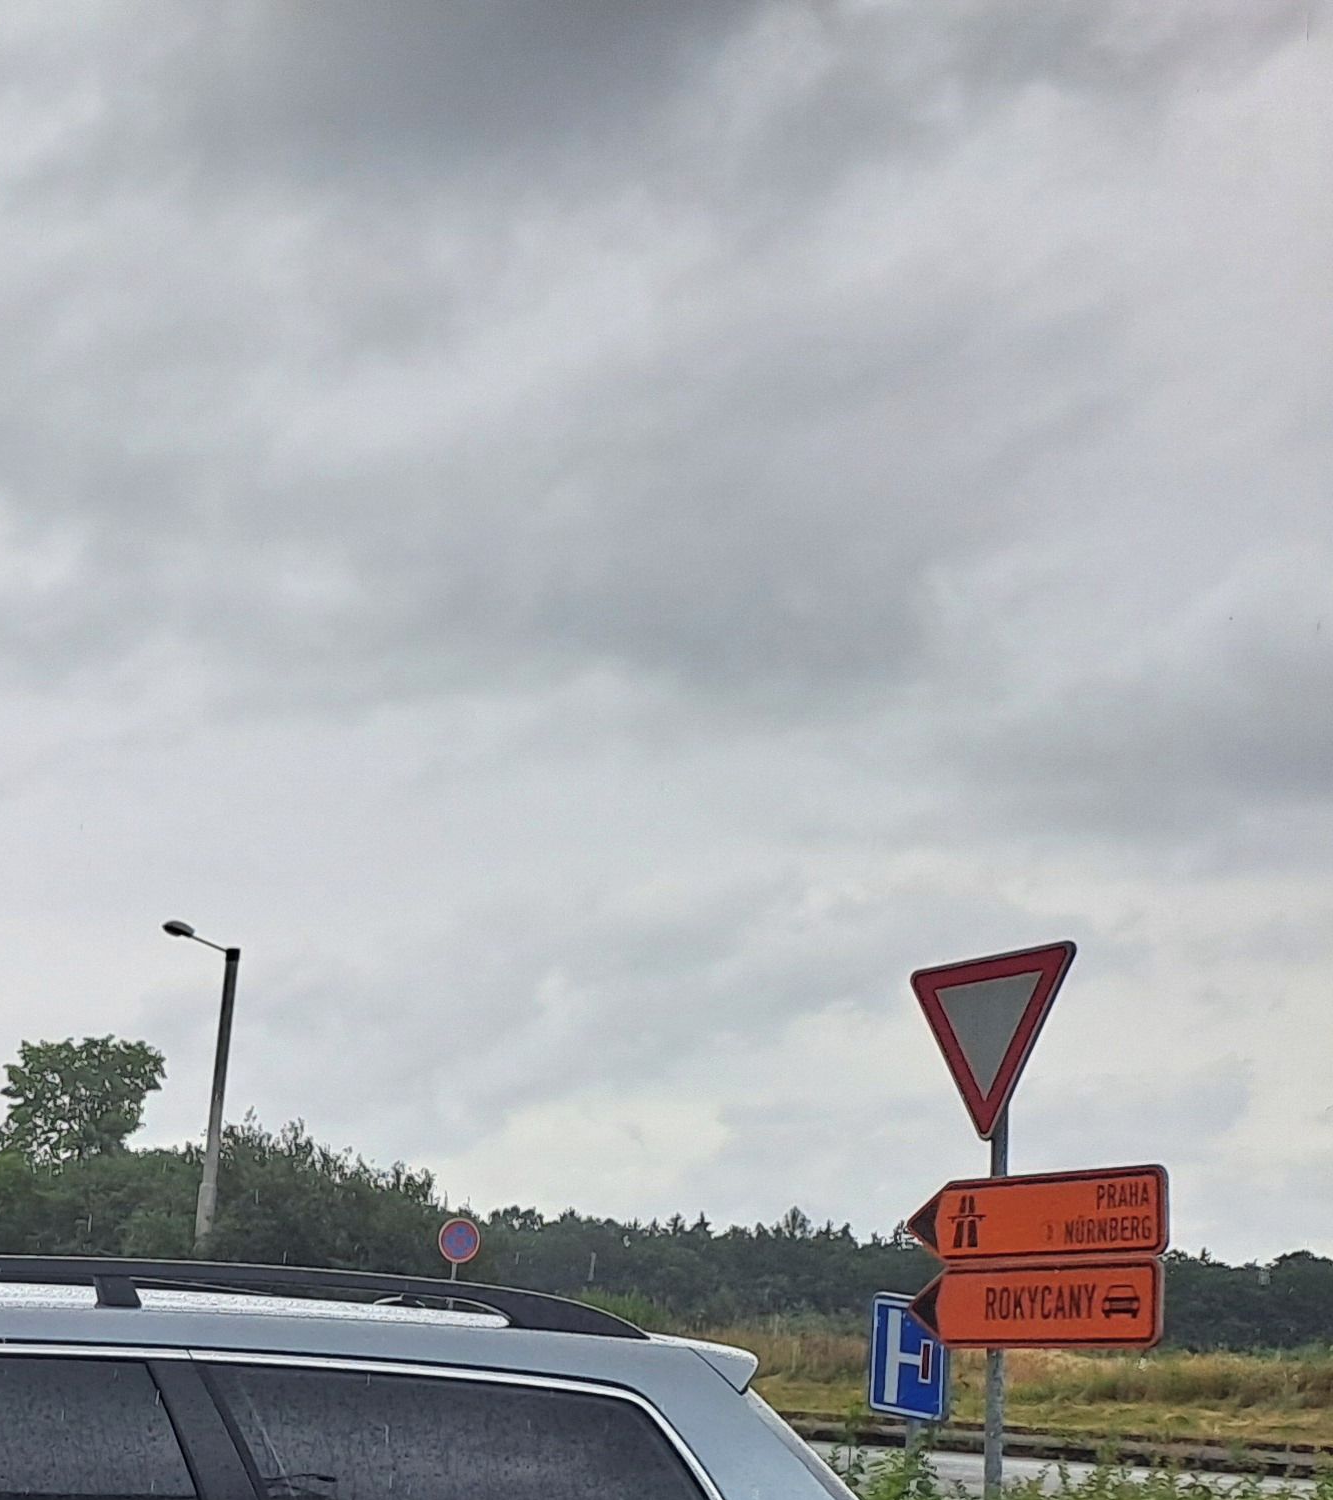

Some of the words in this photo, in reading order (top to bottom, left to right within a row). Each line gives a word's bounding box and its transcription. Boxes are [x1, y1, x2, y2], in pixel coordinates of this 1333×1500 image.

[1096, 1182, 1150, 1210] PRAHA
[1064, 1215, 1152, 1244] NÜRNBERG
[985, 1284, 1096, 1320] ROKYCANY
